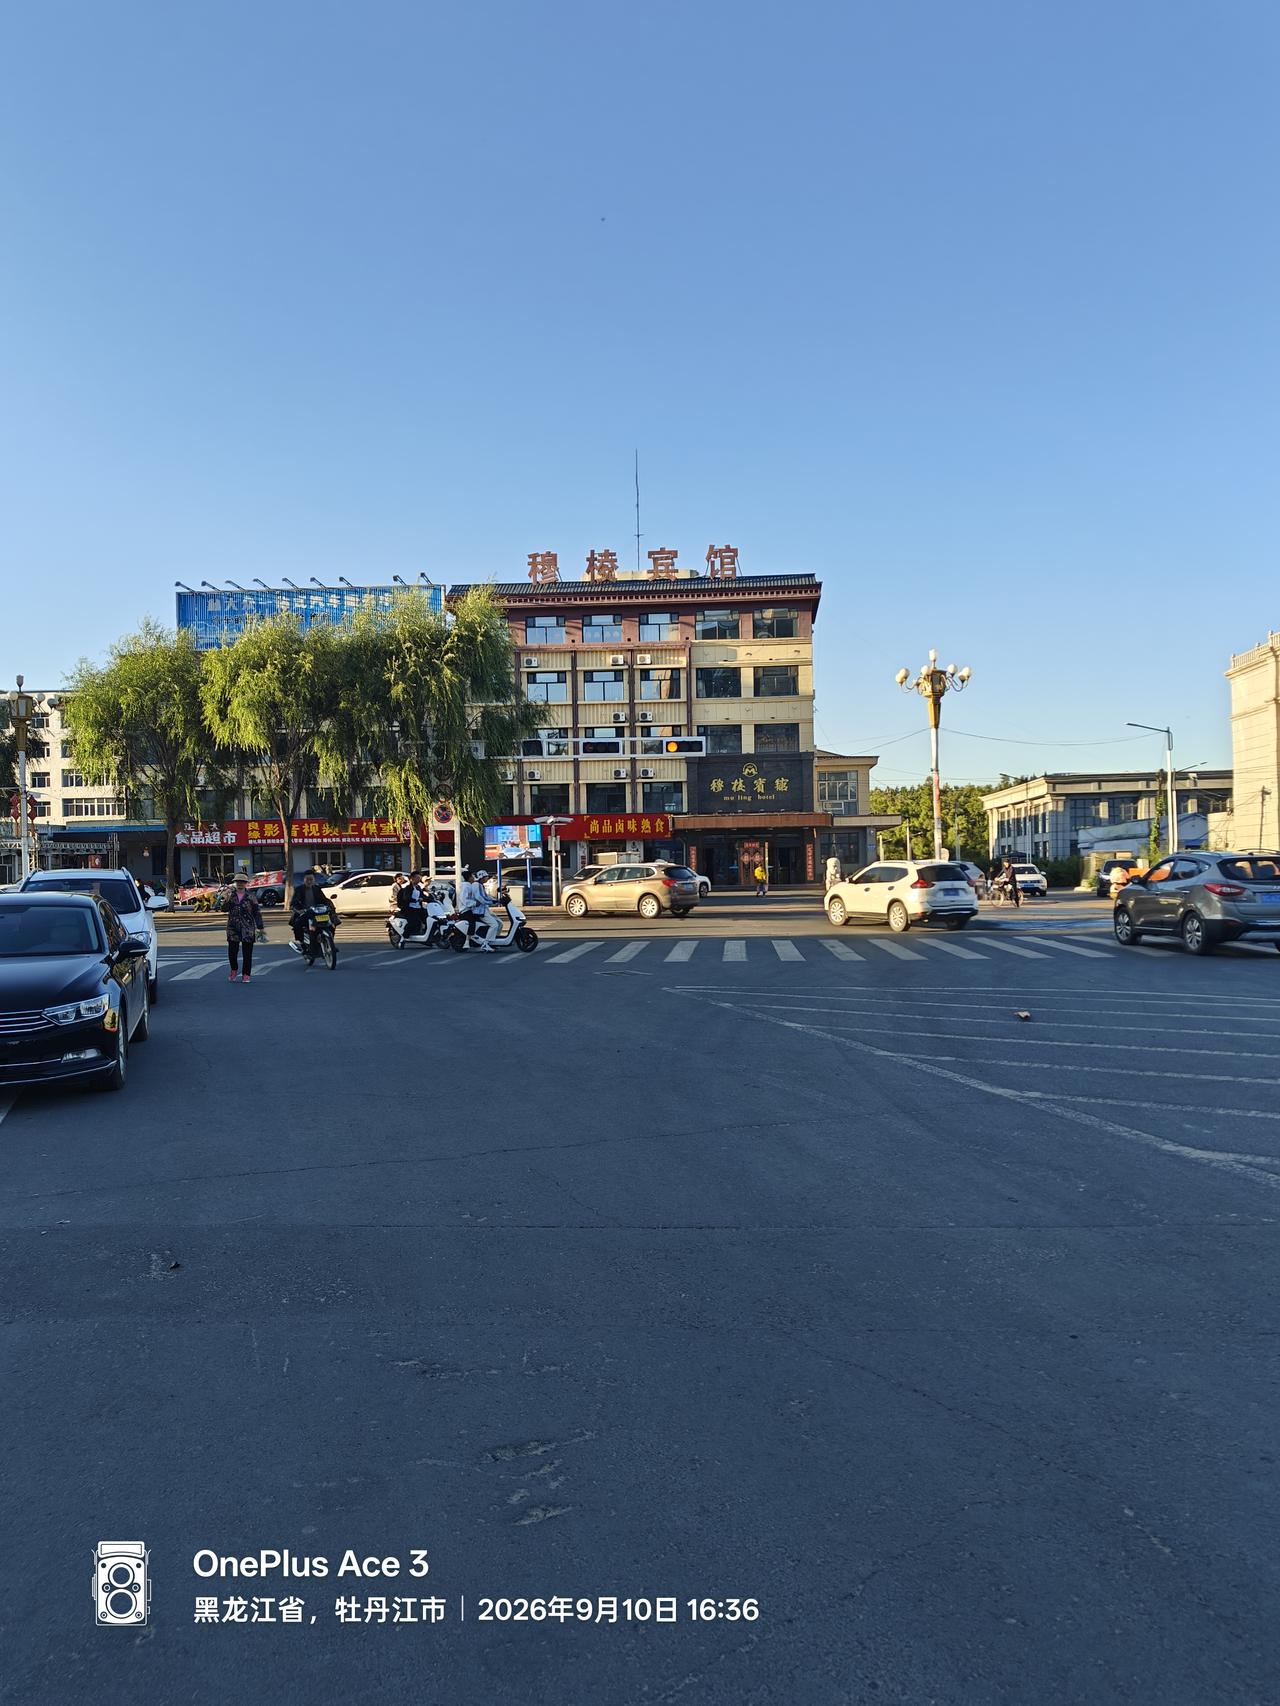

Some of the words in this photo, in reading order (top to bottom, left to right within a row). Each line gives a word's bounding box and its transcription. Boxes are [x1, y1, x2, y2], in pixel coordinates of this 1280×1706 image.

[527, 544, 739, 586] 穆棱宾馆
[590, 818, 665, 834] 尚品卤味熟食
[175, 830, 238, 845] 食品超市
